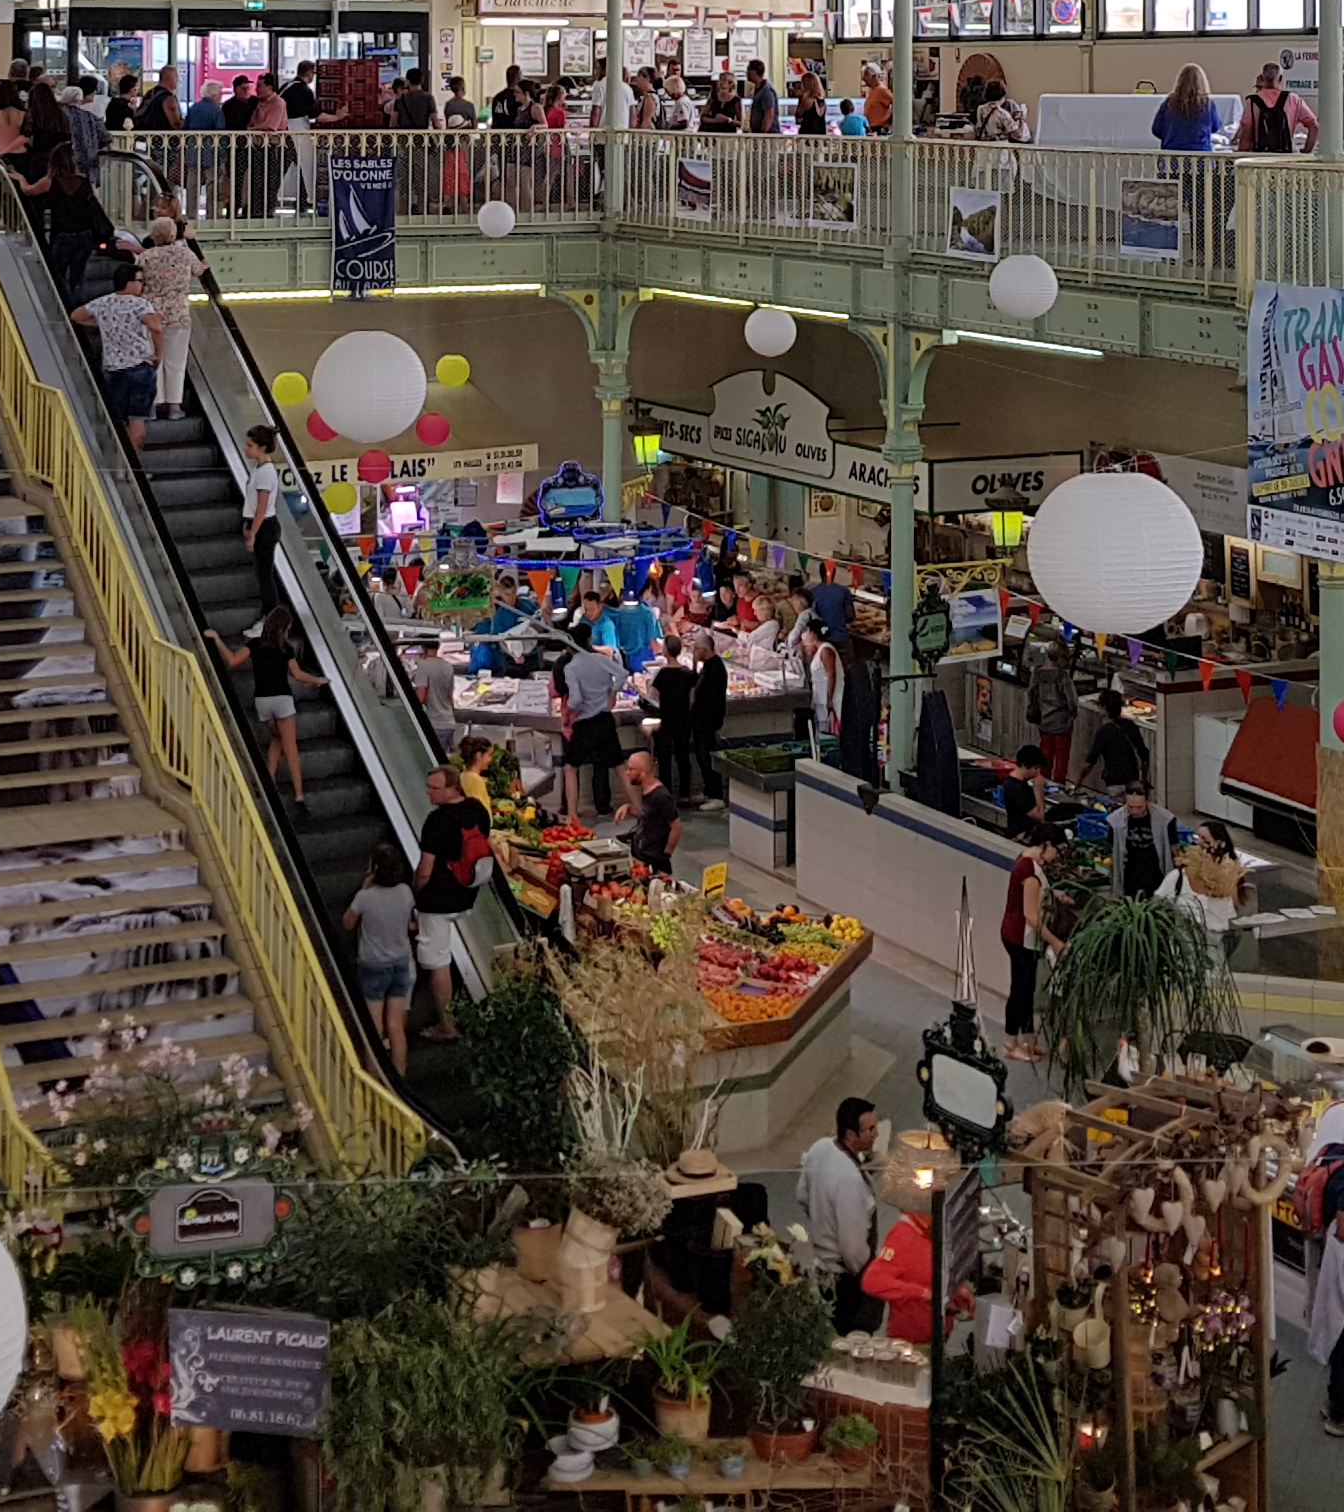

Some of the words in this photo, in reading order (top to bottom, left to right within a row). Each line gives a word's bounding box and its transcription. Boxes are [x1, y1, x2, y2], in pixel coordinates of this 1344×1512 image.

[332, 159, 352, 169] LES
[353, 159, 393, 169] SABLES
[333, 169, 394, 181] D'OLONNE
[1298, 335, 1344, 391] GAS
[1308, 383, 1343, 444] CO
[795, 443, 828, 463] OLIVES
[332, 465, 348, 482] LE
[848, 461, 919, 496] ARACHS
[207, 1326, 273, 1345] LAURENT
[275, 1331, 329, 1349] PICAUD
